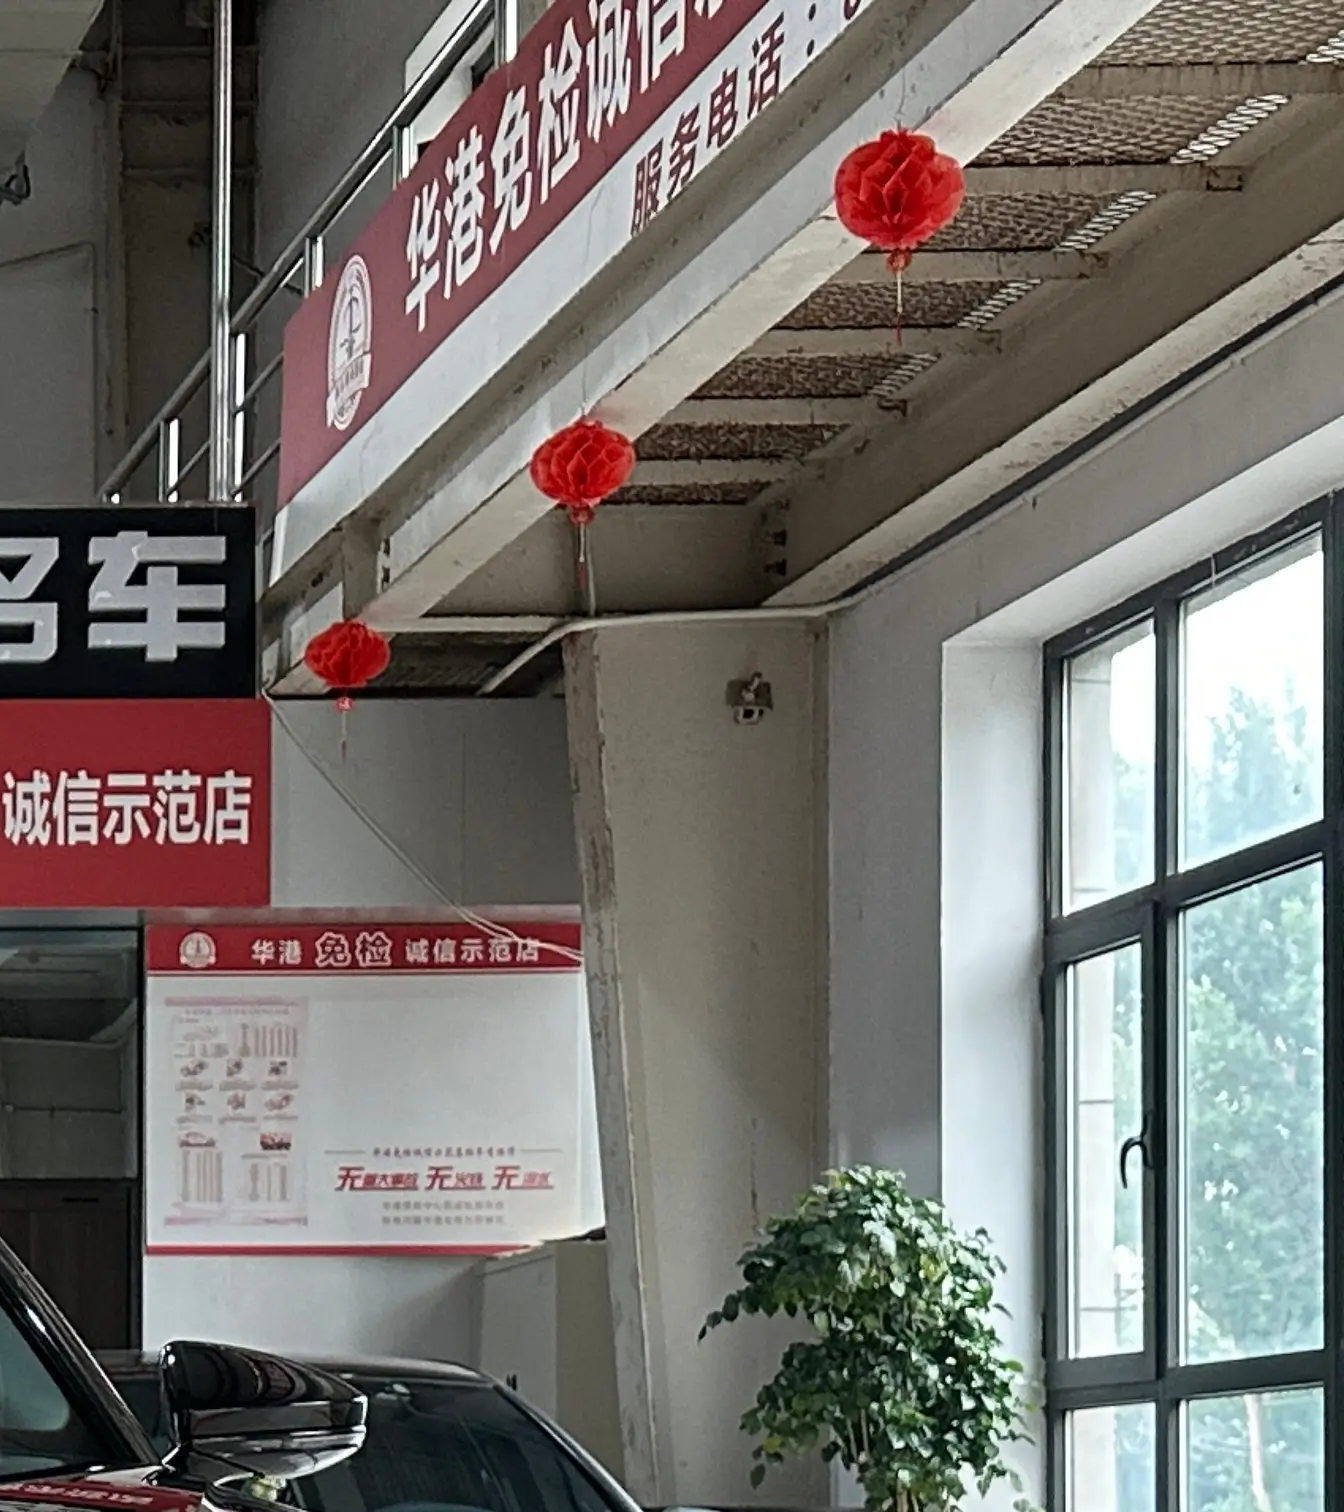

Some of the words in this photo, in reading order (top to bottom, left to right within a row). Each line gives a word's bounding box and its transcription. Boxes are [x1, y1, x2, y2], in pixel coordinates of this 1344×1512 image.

[405, 0, 723, 332] 华港免检诚信
